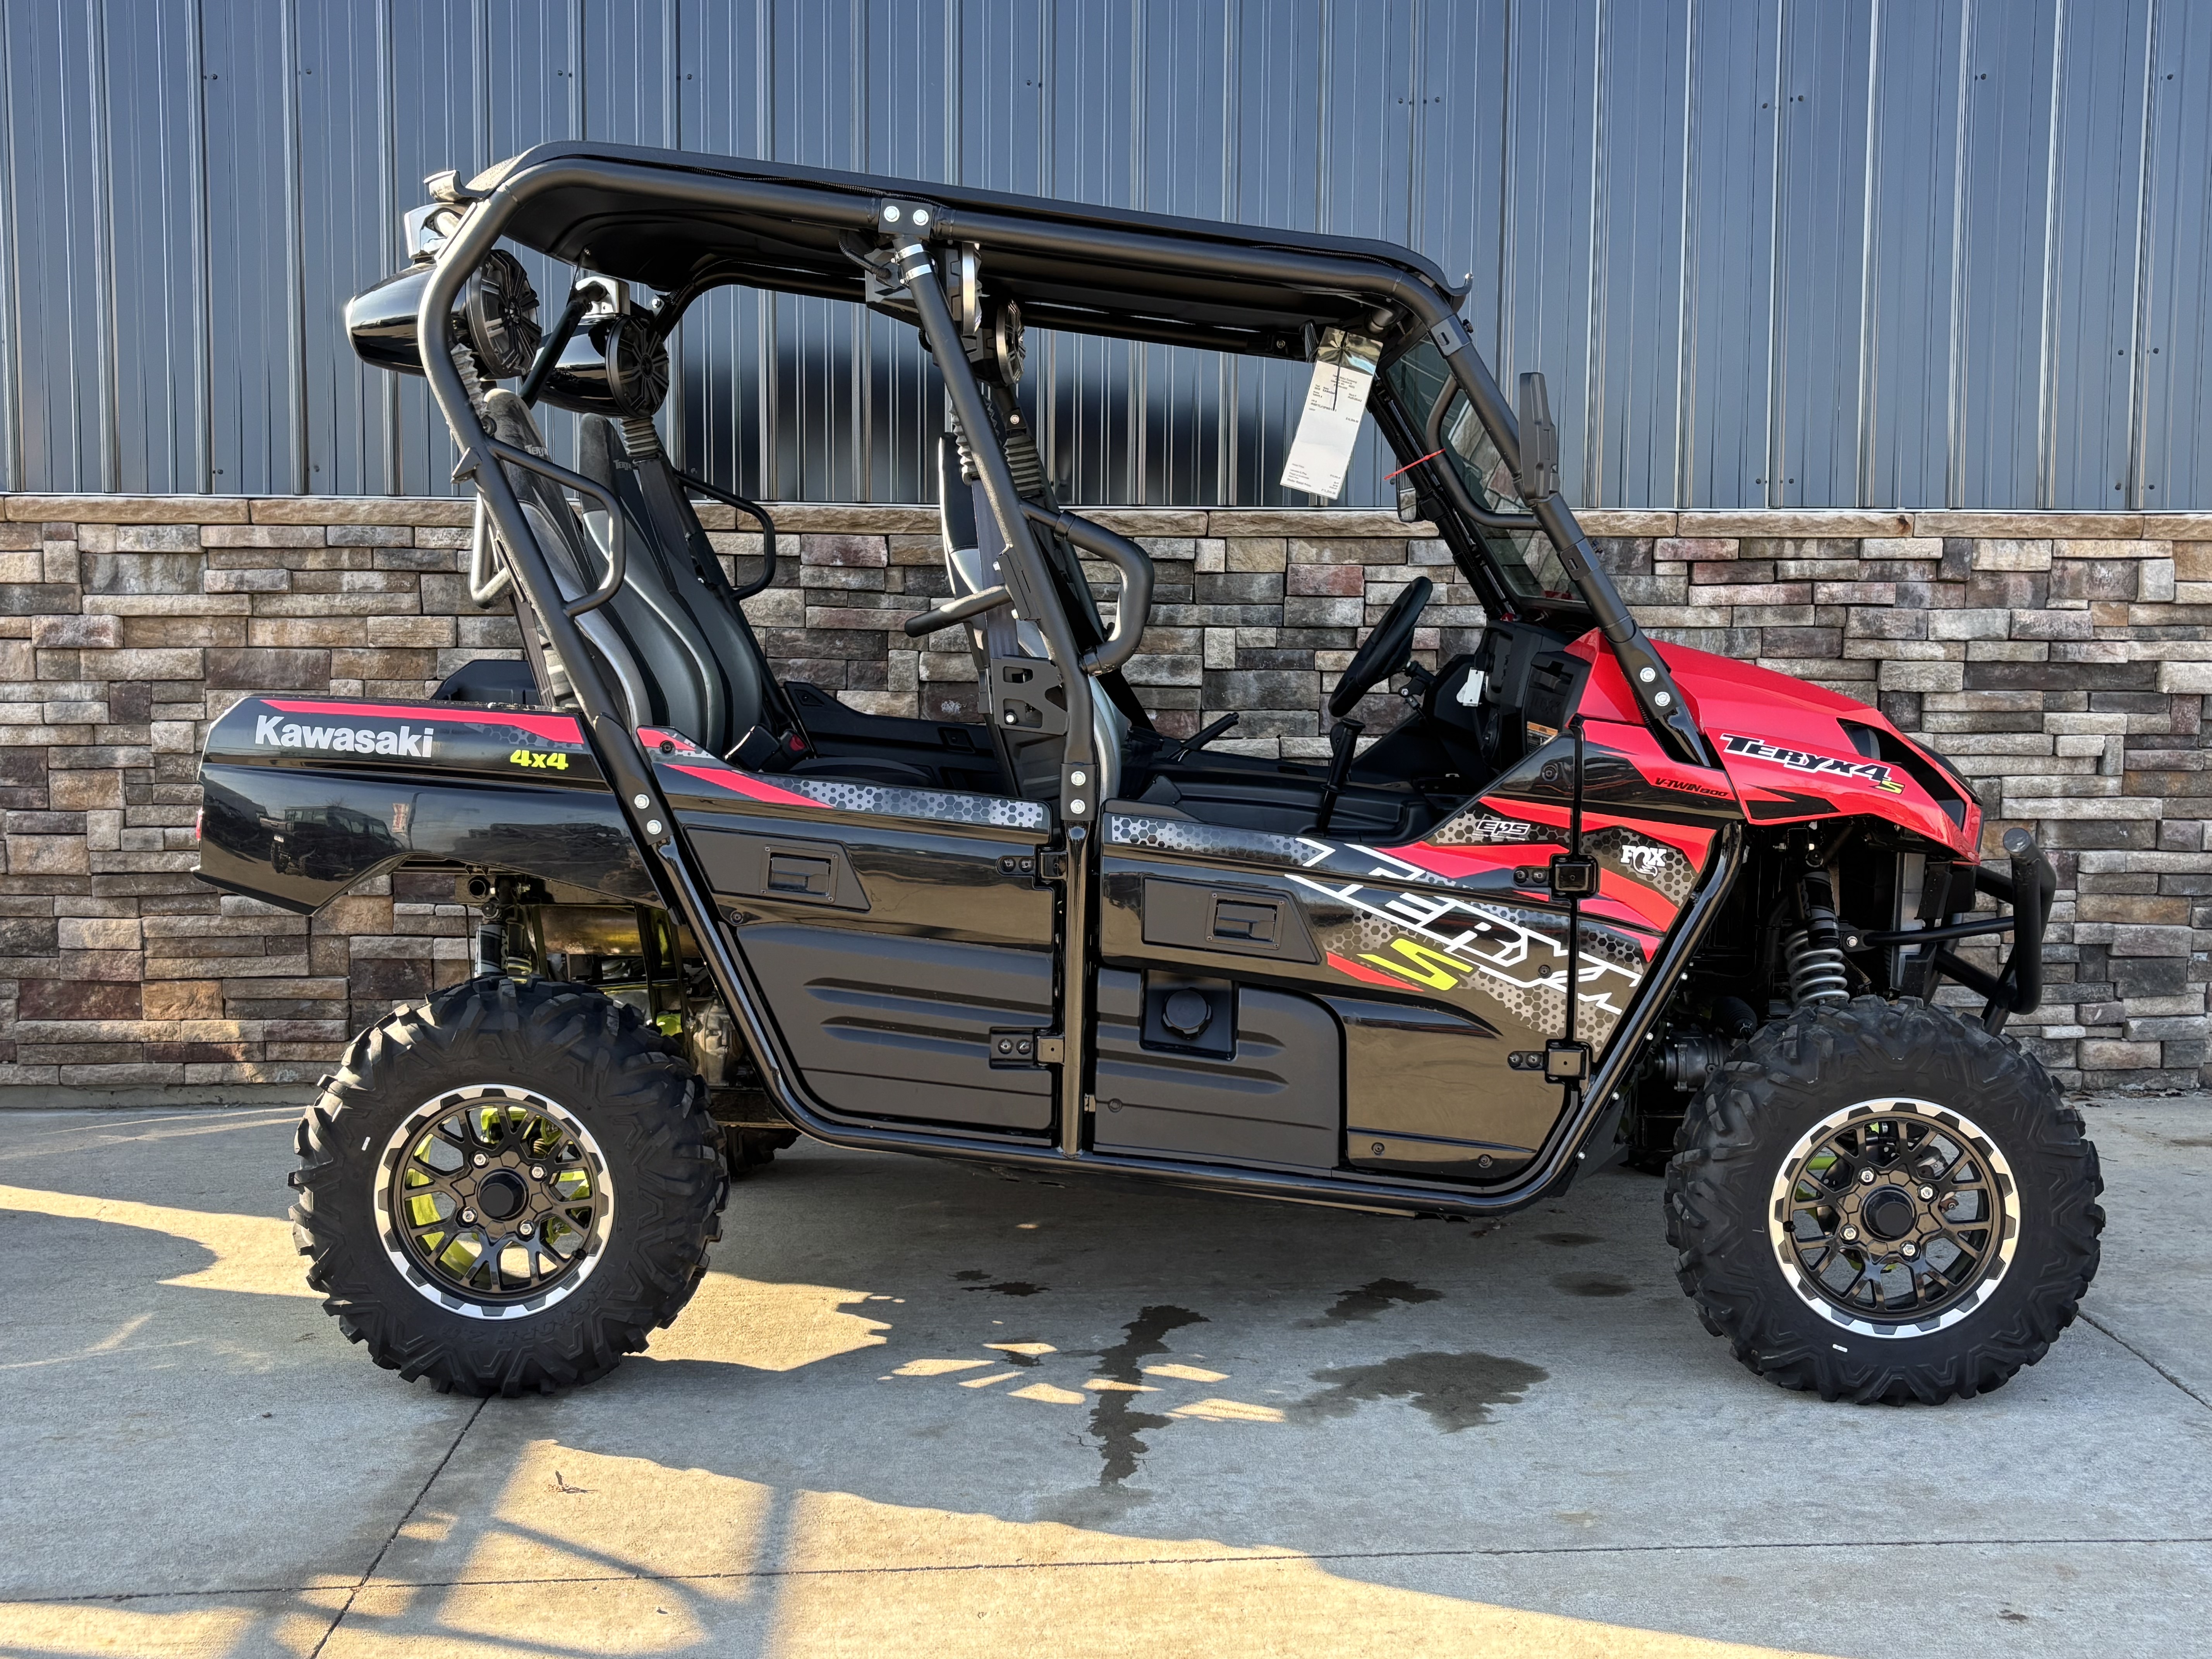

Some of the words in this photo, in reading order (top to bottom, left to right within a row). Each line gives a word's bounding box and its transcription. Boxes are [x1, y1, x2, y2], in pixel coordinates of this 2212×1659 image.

[255, 714, 434, 758] Kawasaki
[510, 749, 569, 770] 4x4
[1655, 777, 1702, 792] V-TWIN
[1700, 788, 1729, 797] 800
[1476, 819, 1531, 835] EPS
[1620, 845, 1667, 877] FOX
[1357, 938, 1474, 991] S
